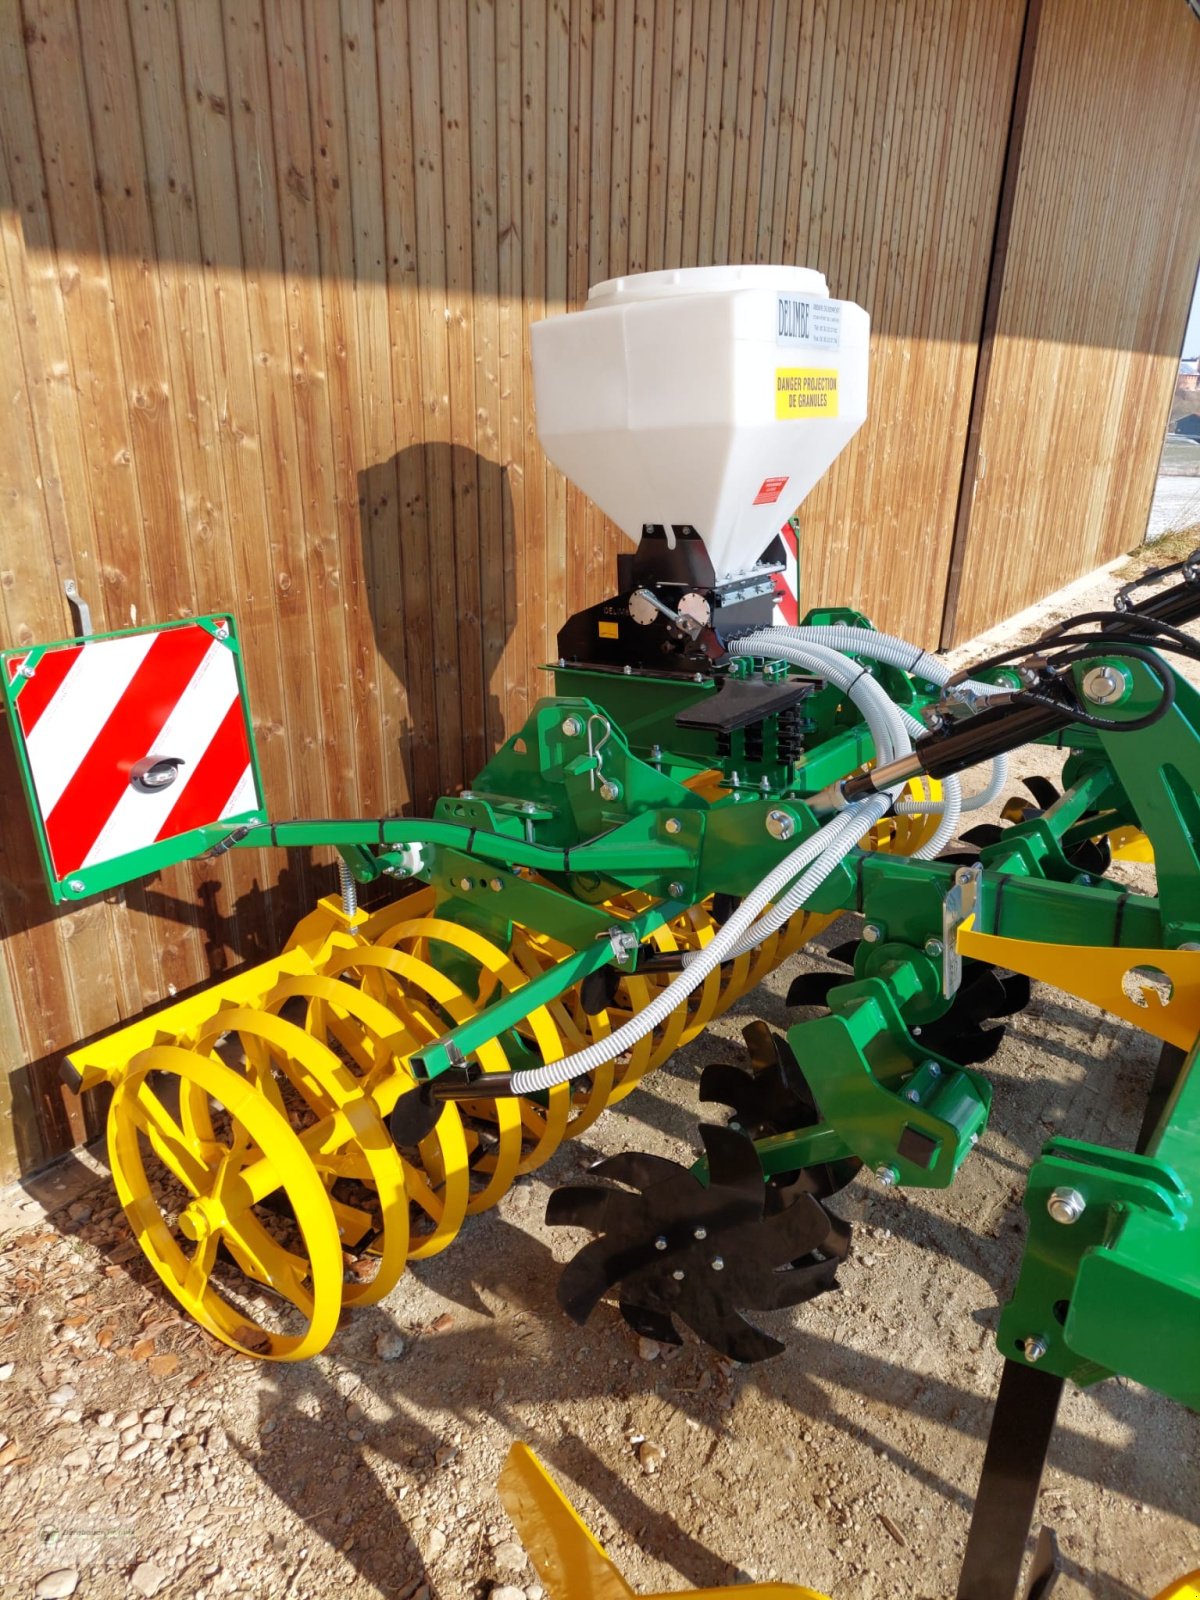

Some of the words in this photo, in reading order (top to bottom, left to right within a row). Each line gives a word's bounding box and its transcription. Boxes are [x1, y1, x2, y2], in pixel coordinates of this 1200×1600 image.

[778, 299, 809, 339] DELIMBE
[777, 377, 802, 391] DANGER
[803, 377, 837, 391] PROJECTION
[788, 394, 797, 408] DE
[798, 393, 828, 408] GRANULES
